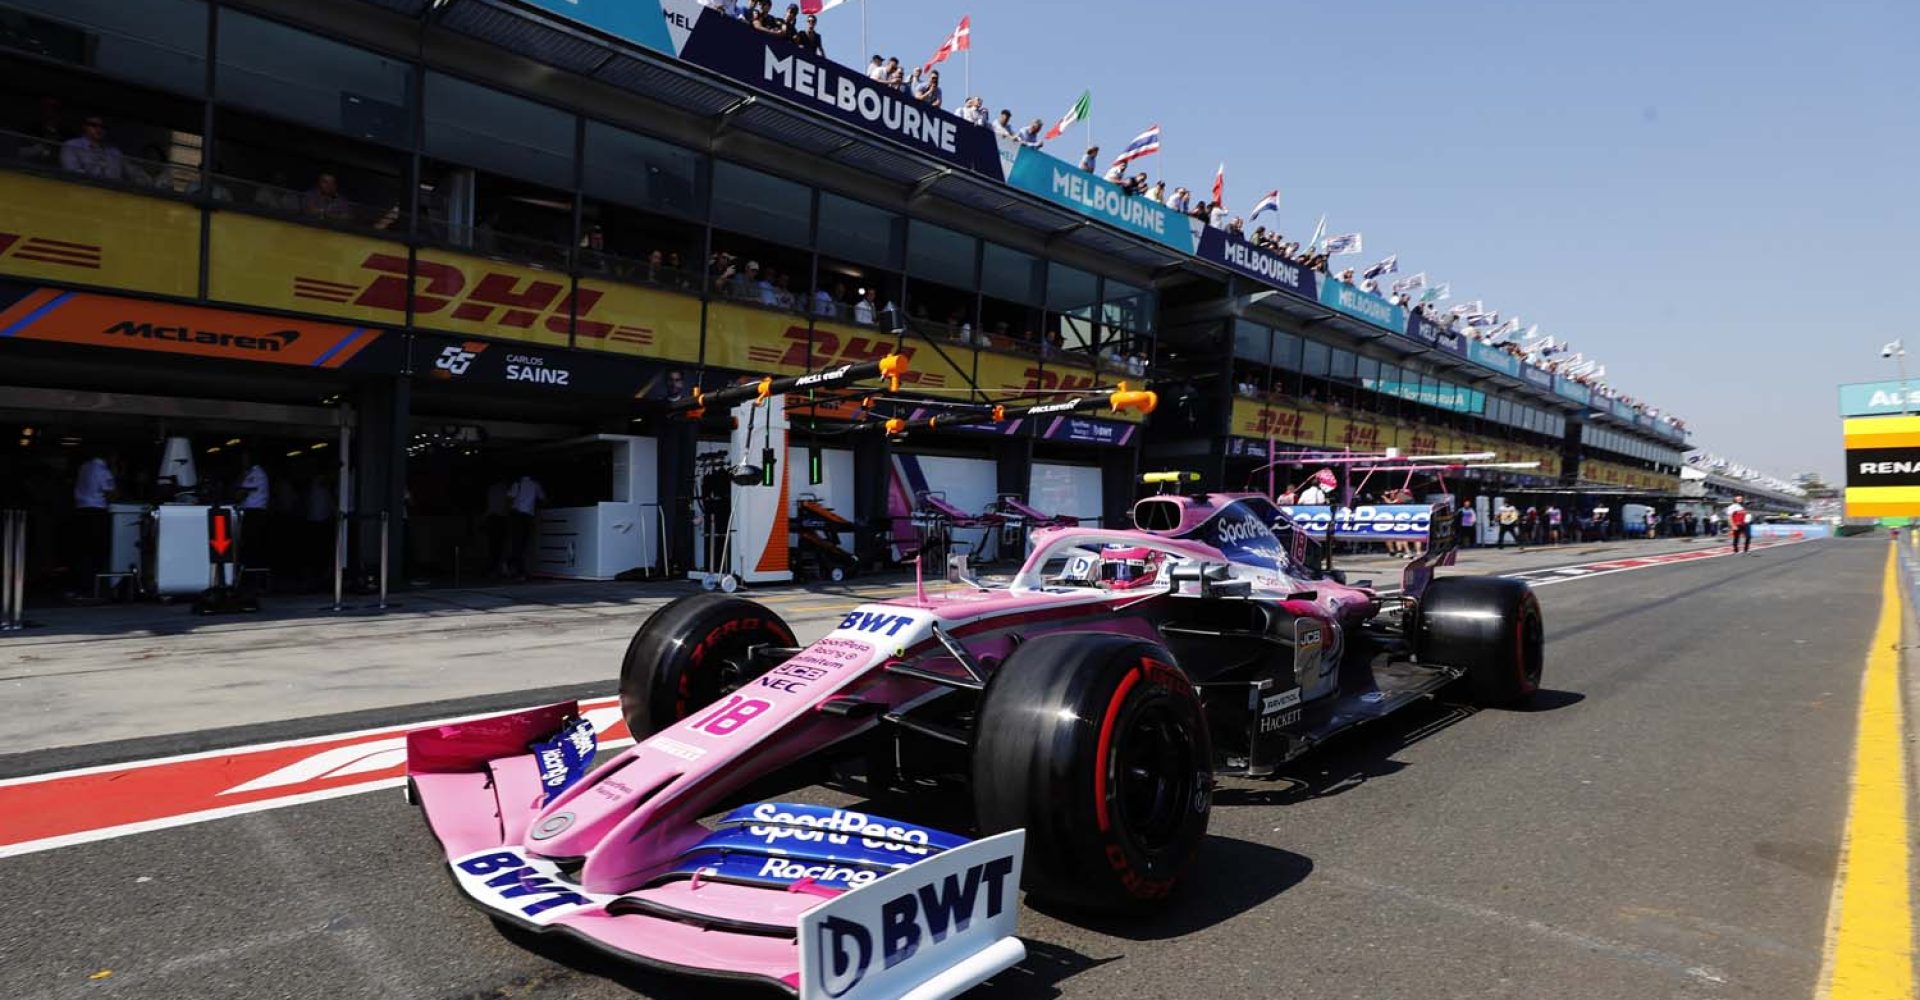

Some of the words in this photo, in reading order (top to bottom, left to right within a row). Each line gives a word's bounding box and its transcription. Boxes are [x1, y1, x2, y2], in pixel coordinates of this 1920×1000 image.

[763, 44, 957, 154] MELBOURNE
[1052, 166, 1166, 234] MELBOURNE
[1224, 239, 1299, 288] MELBOURNE
[353, 252, 615, 340] DHL
[103, 321, 282, 351] McLaren
[435, 346, 474, 375] 55
[505, 364, 570, 386] SAINZ
[506, 353, 544, 366] CARLOS
[1027, 400, 1077, 415] McLaren
[837, 611, 914, 637] BWT
[760, 676, 807, 694] NEC
[690, 694, 772, 736] 18
[1261, 709, 1301, 733] HACKETT
[752, 803, 929, 853] SportPesa
[457, 852, 594, 916] BWT
[758, 850, 878, 889] Racing
[881, 855, 1014, 970] BWT
